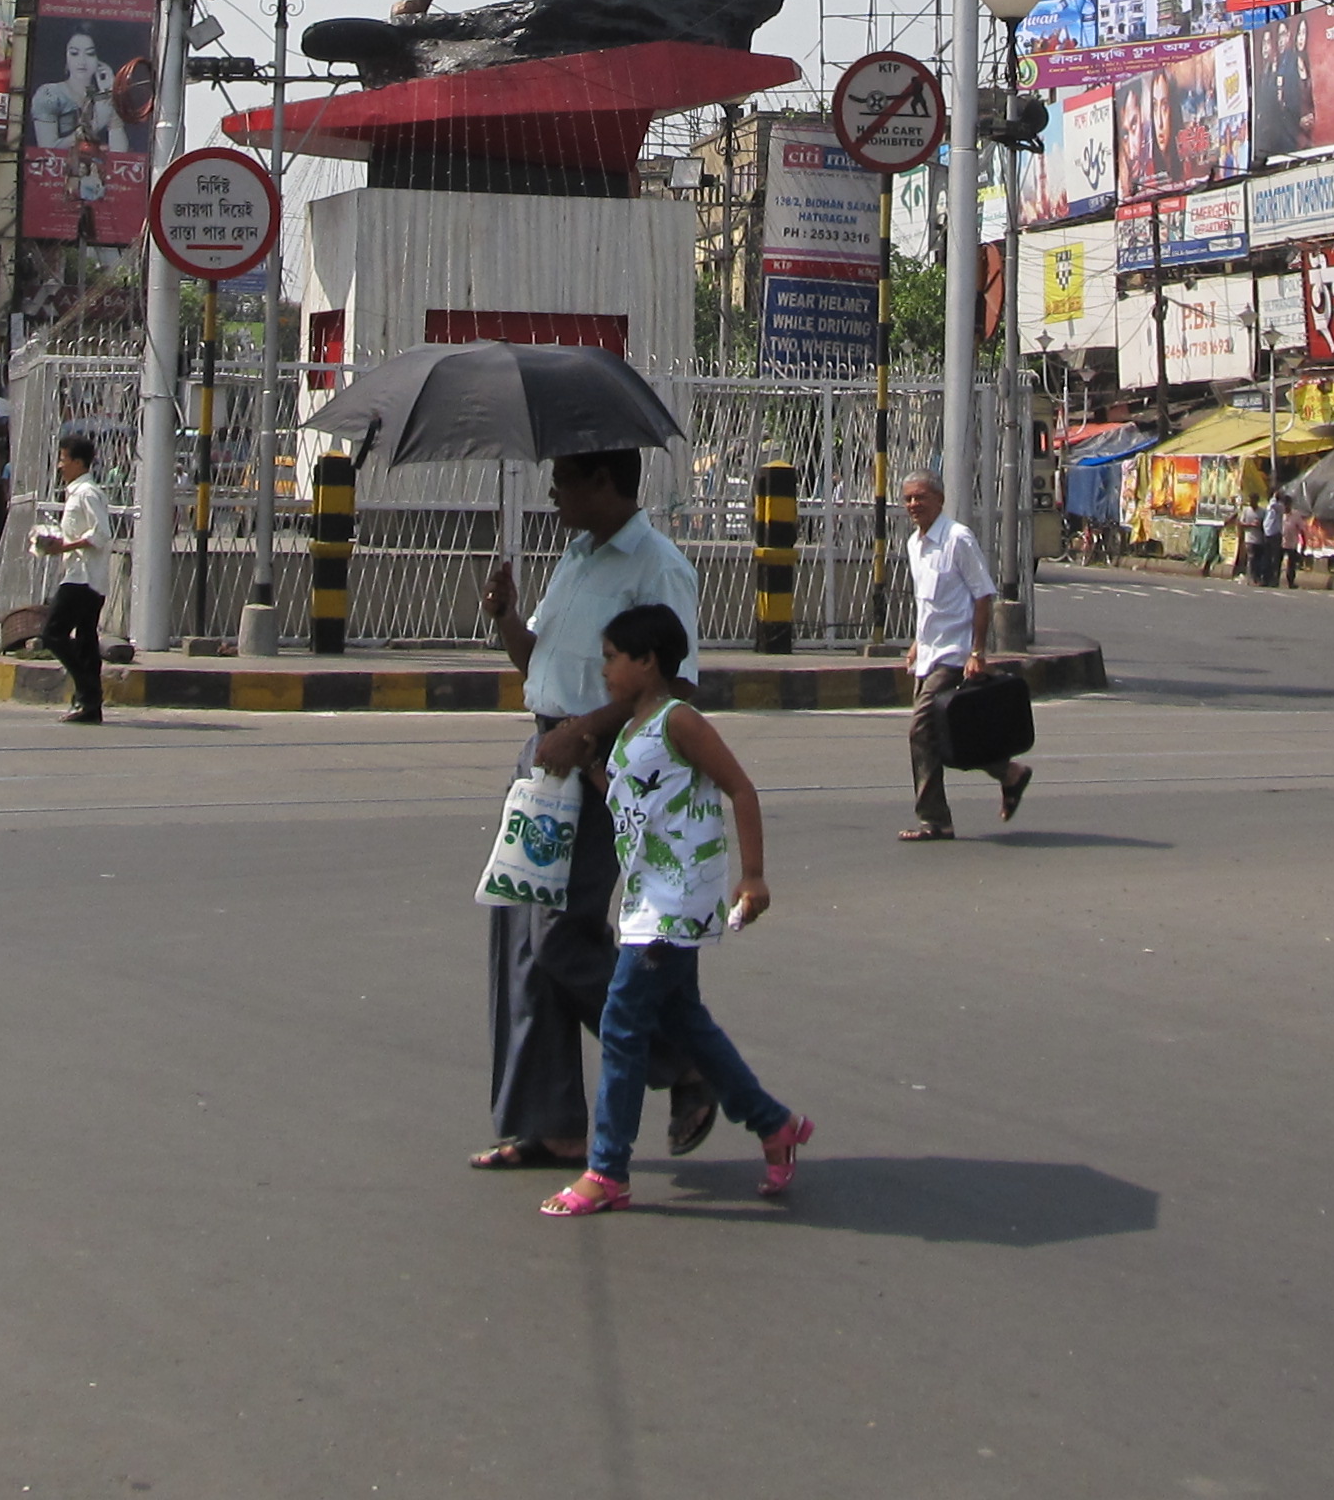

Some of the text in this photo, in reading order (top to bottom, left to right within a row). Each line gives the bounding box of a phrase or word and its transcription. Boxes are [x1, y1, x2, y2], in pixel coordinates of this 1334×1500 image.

[1048, 51, 1083, 65] জীবন
[892, 126, 923, 136] CART
[856, 137, 924, 147] OHIBITED
[787, 146, 820, 164] citi
[197, 175, 231, 195] নির্দিষ্ট
[173, 198, 254, 218] জায়গা দিয়েই
[805, 198, 880, 213] BIDHAN SARAN
[1191, 200, 1242, 223] EMERGENCY
[169, 225, 258, 241] রাস্তা পার হোন
[783, 227, 800, 238] PH
[777, 291, 871, 313] WEAR HELMET
[772, 313, 871, 337] WHILE DRIVING
[769, 336, 873, 360] TWO WHEELERS
